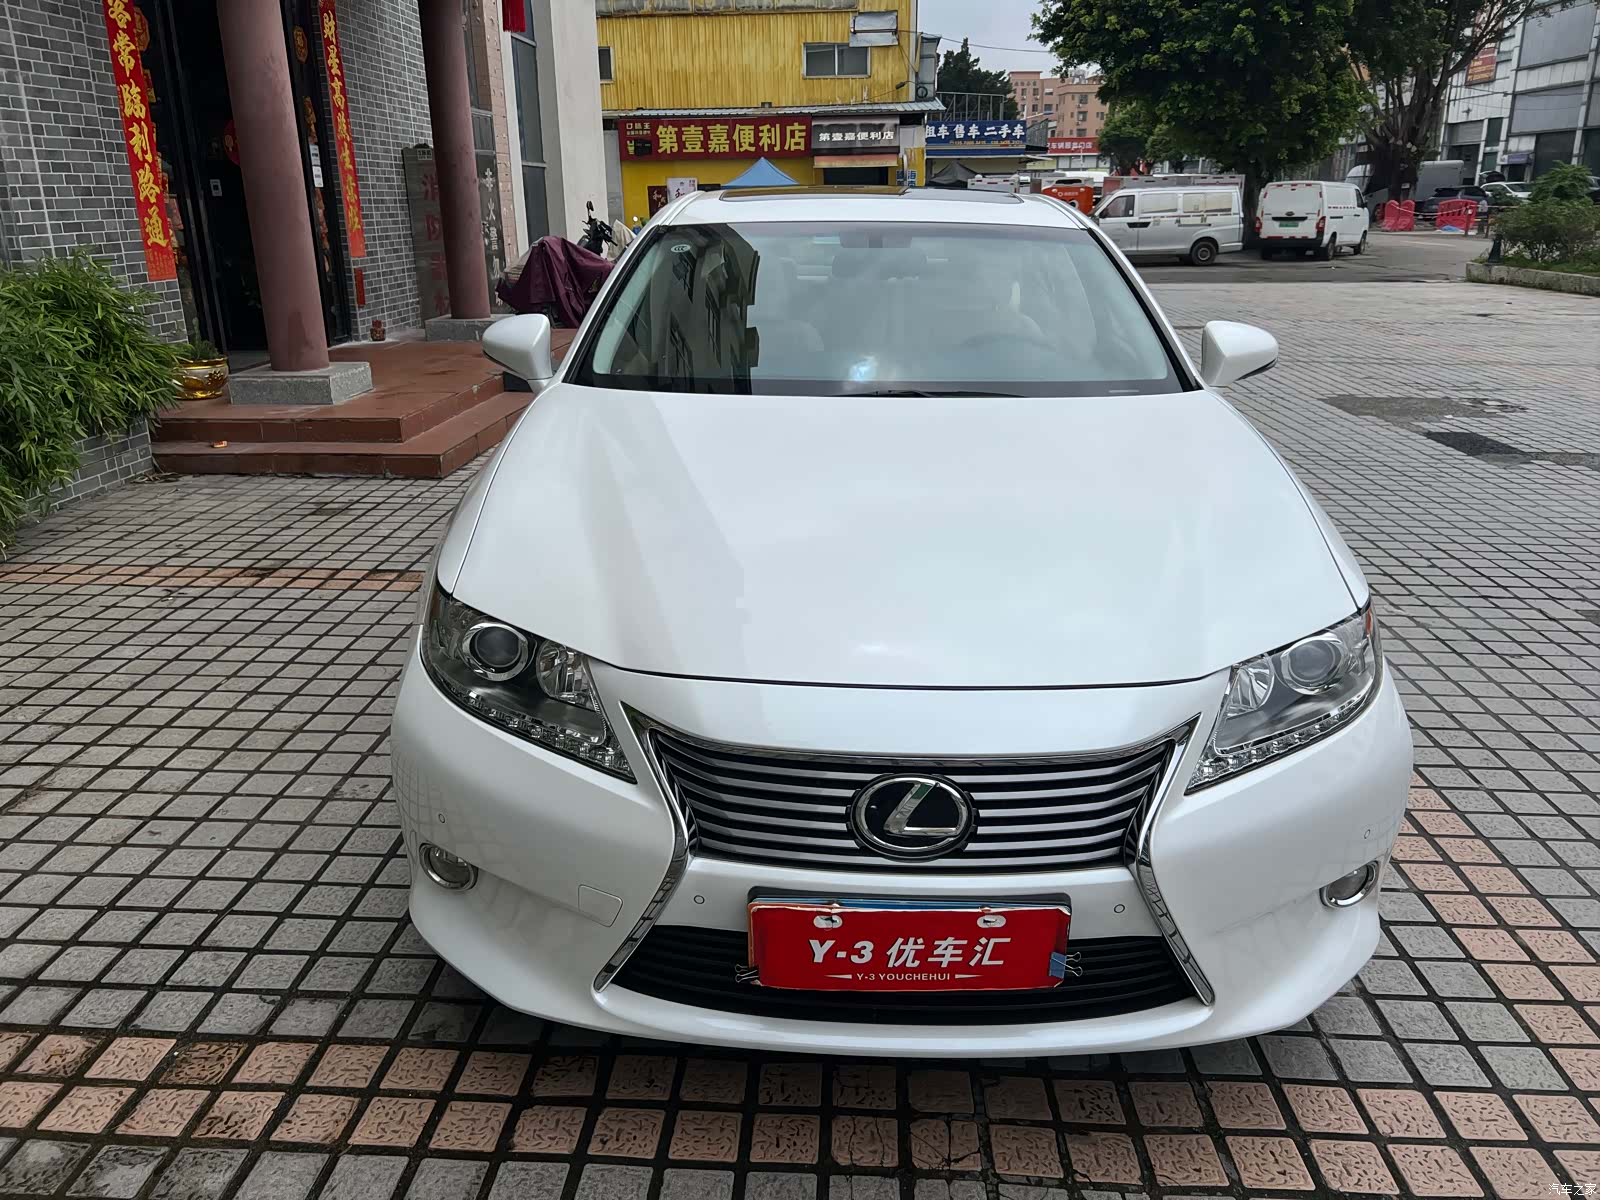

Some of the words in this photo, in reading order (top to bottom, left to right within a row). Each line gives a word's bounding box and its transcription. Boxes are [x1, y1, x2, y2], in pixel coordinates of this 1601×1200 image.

[656, 122, 807, 154] 第壹嘉便利店
[818, 131, 895, 142] 第壹嘉便利店
[953, 124, 980, 139] 售车
[984, 124, 1025, 139] 二手车
[809, 939, 874, 964] Y-3
[886, 937, 1012, 968] 优车汇
[857, 973, 876, 981] Y-3
[878, 973, 950, 981] YOUCHEHUI
